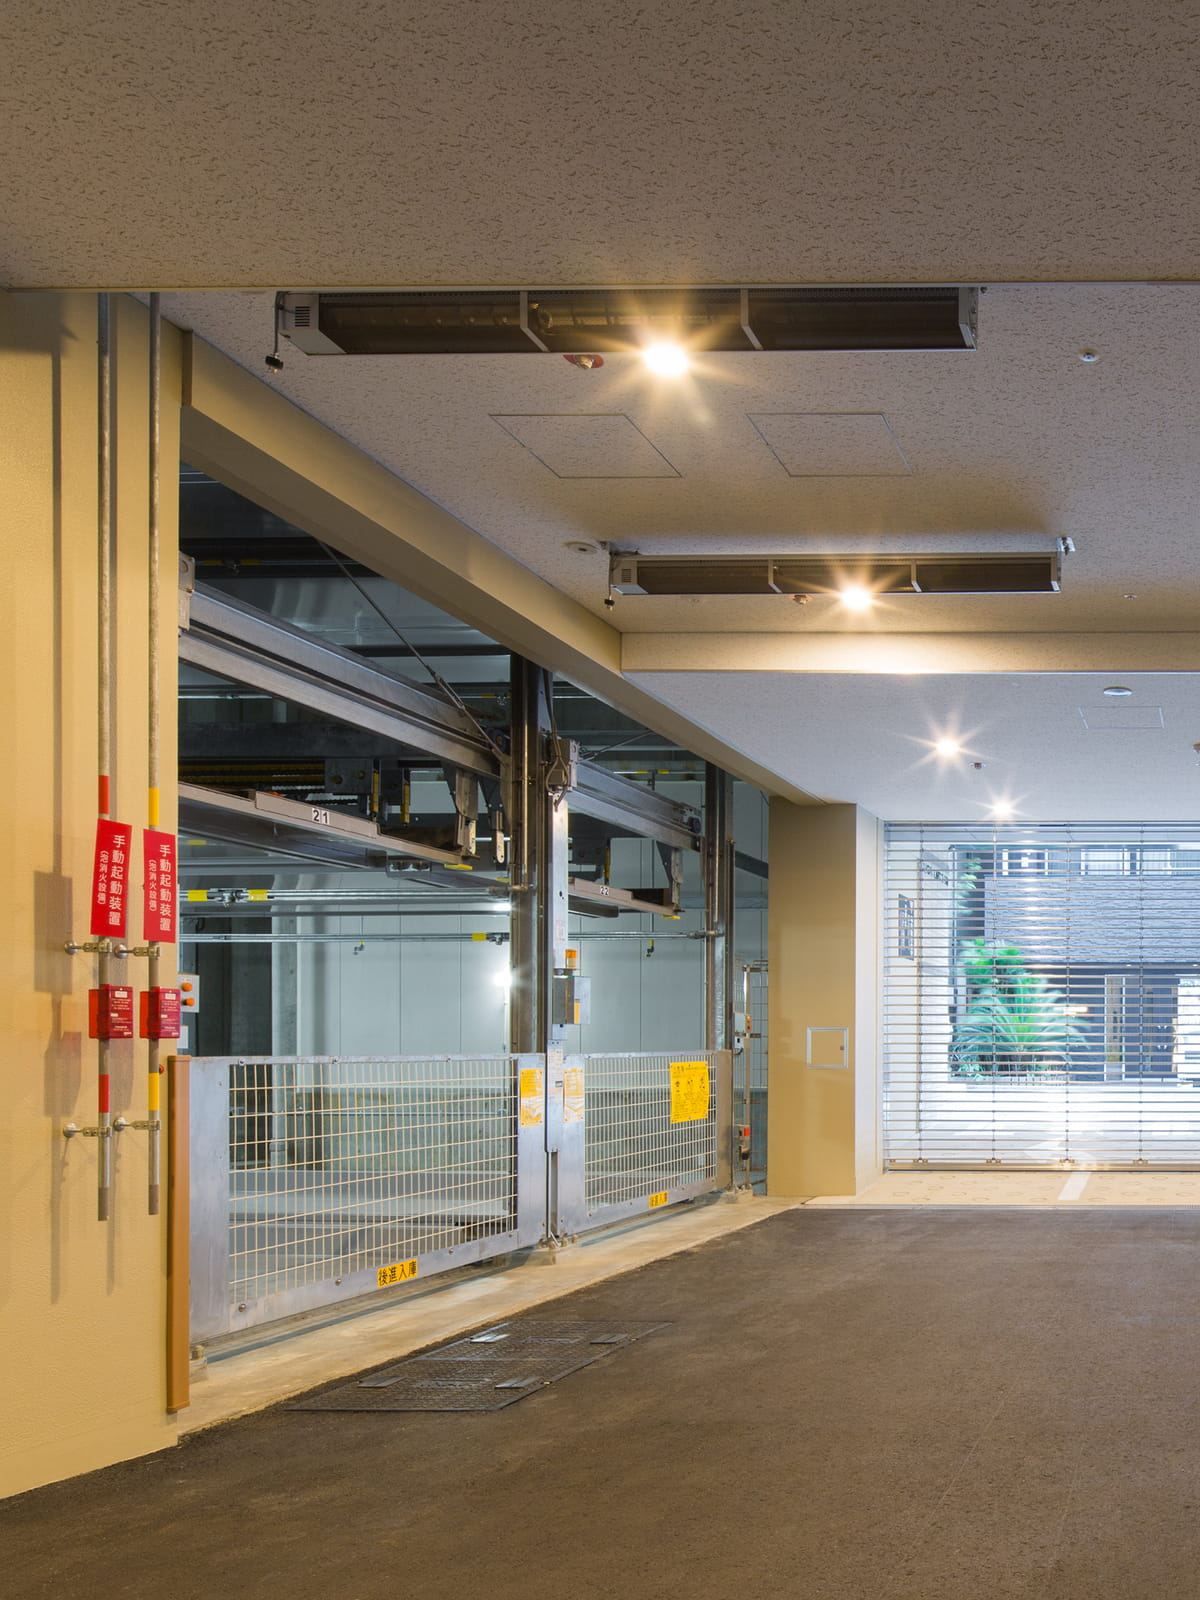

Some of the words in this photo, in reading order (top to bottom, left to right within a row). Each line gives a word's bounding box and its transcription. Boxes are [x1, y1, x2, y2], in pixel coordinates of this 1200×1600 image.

[313, 809, 328, 824] 21
[109, 834, 126, 926] 手動起動装置
[159, 844, 172, 931] 手動起動装置
[378, 1260, 417, 1286] 後進入庫
